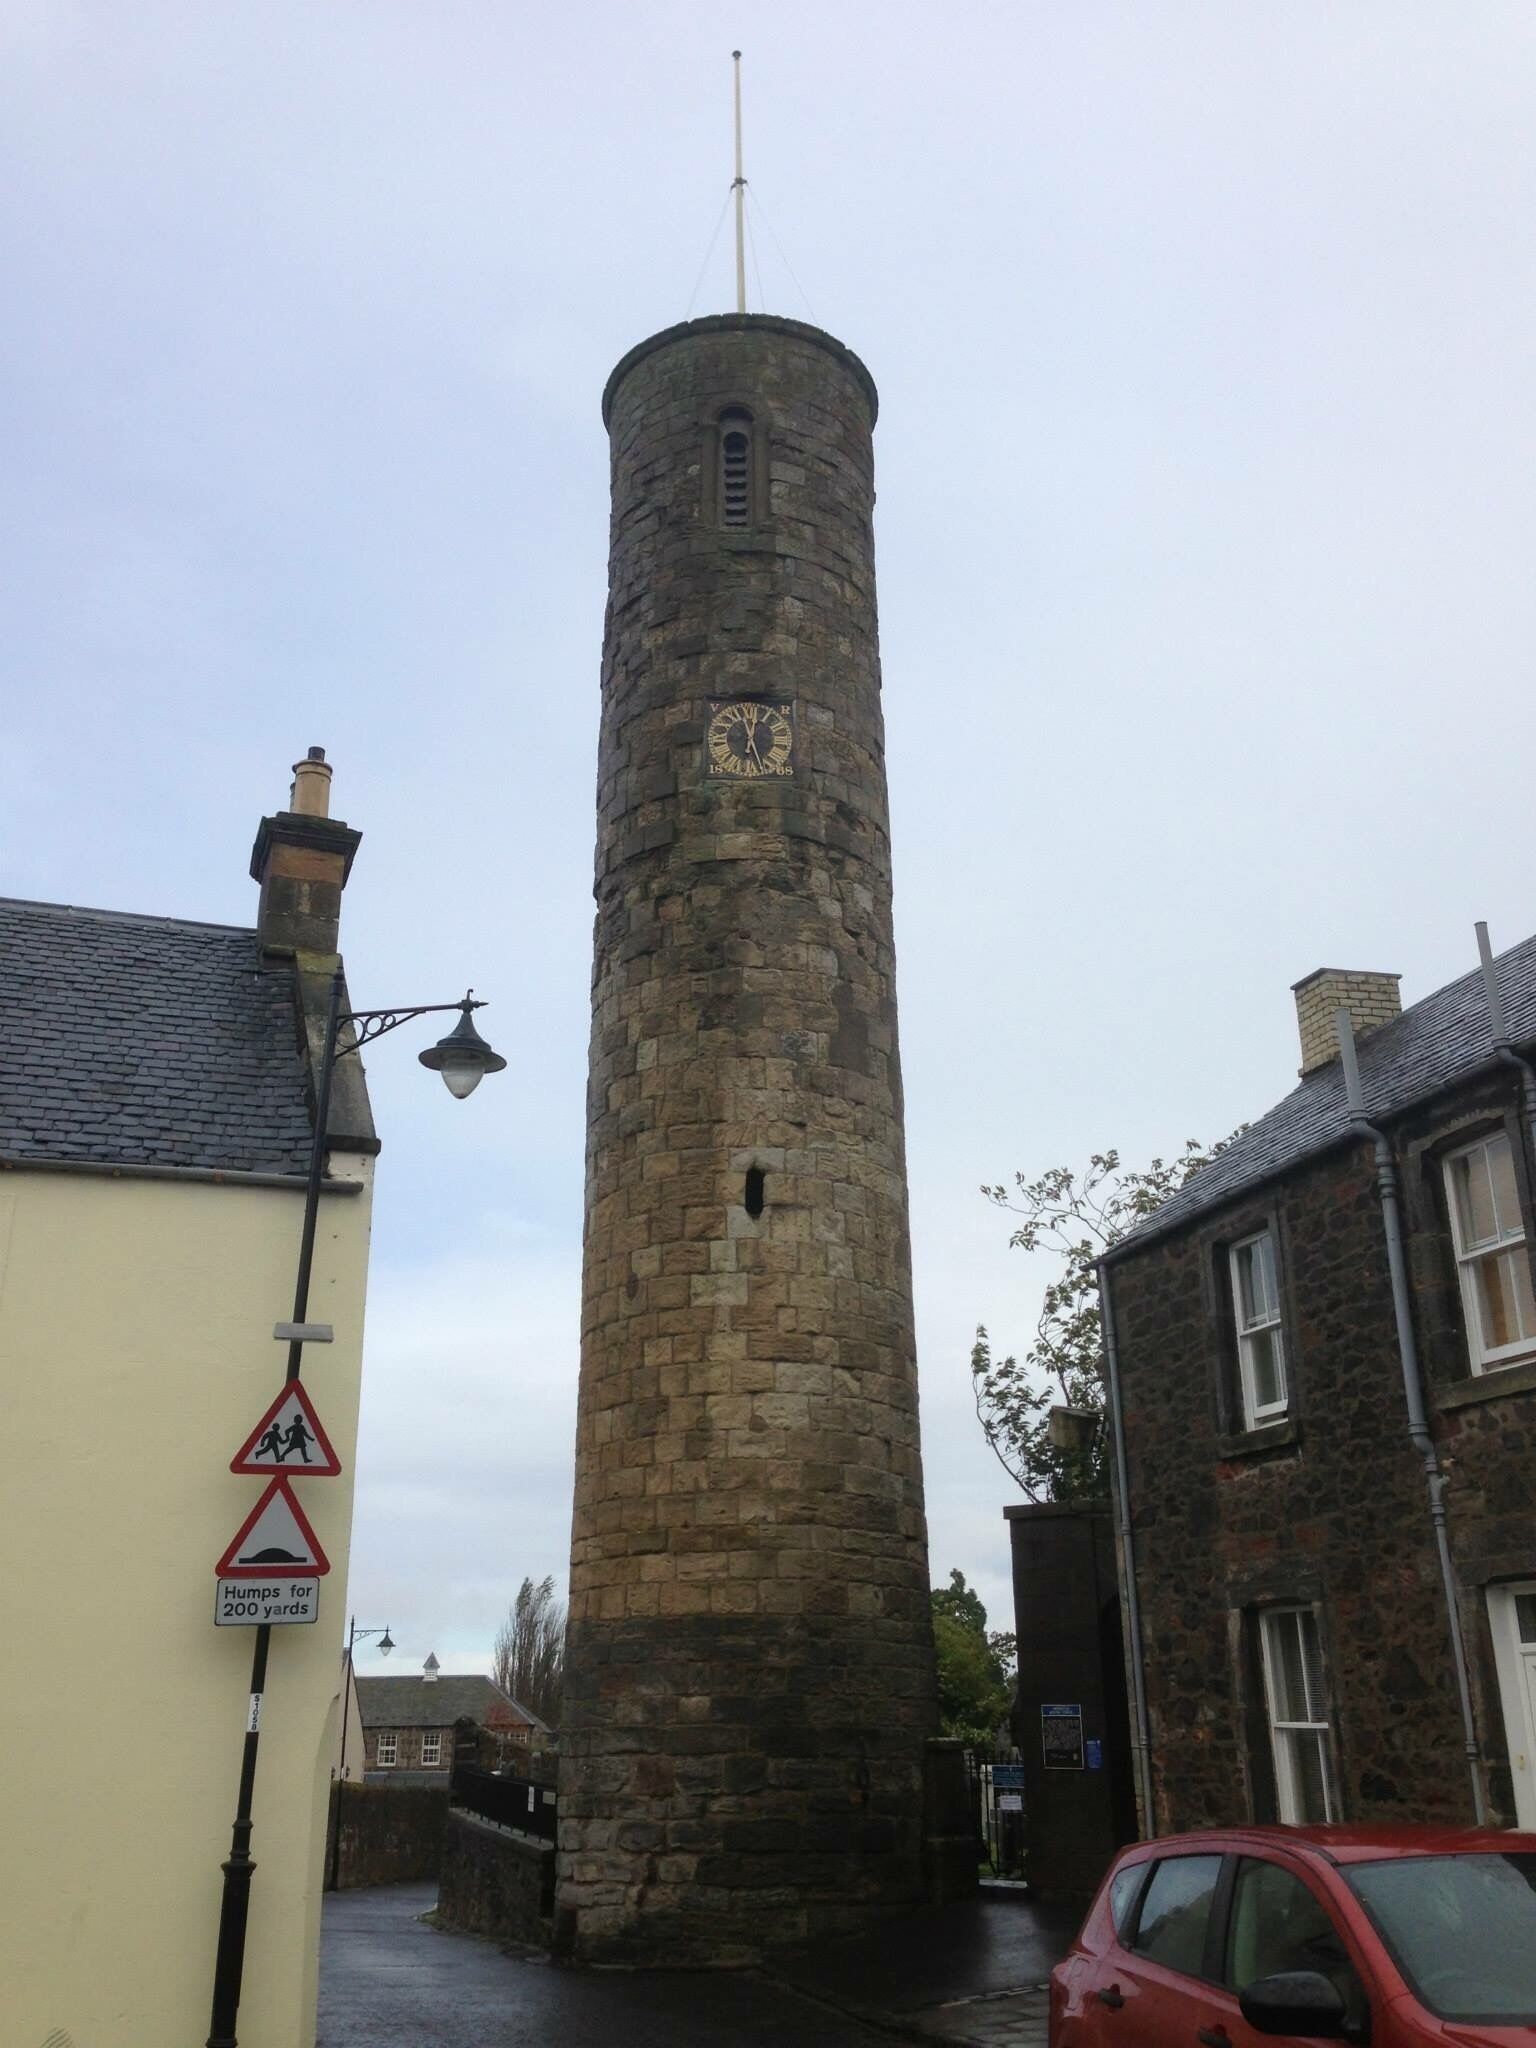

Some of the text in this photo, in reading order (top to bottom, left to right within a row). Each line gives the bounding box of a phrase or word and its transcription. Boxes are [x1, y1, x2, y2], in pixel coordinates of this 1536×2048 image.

[710, 703, 720, 713] V
[781, 705, 791, 715] R
[710, 765, 723, 774] 18
[225, 1584, 312, 1601] Humps for
[223, 1602, 309, 1619] 200 yards
